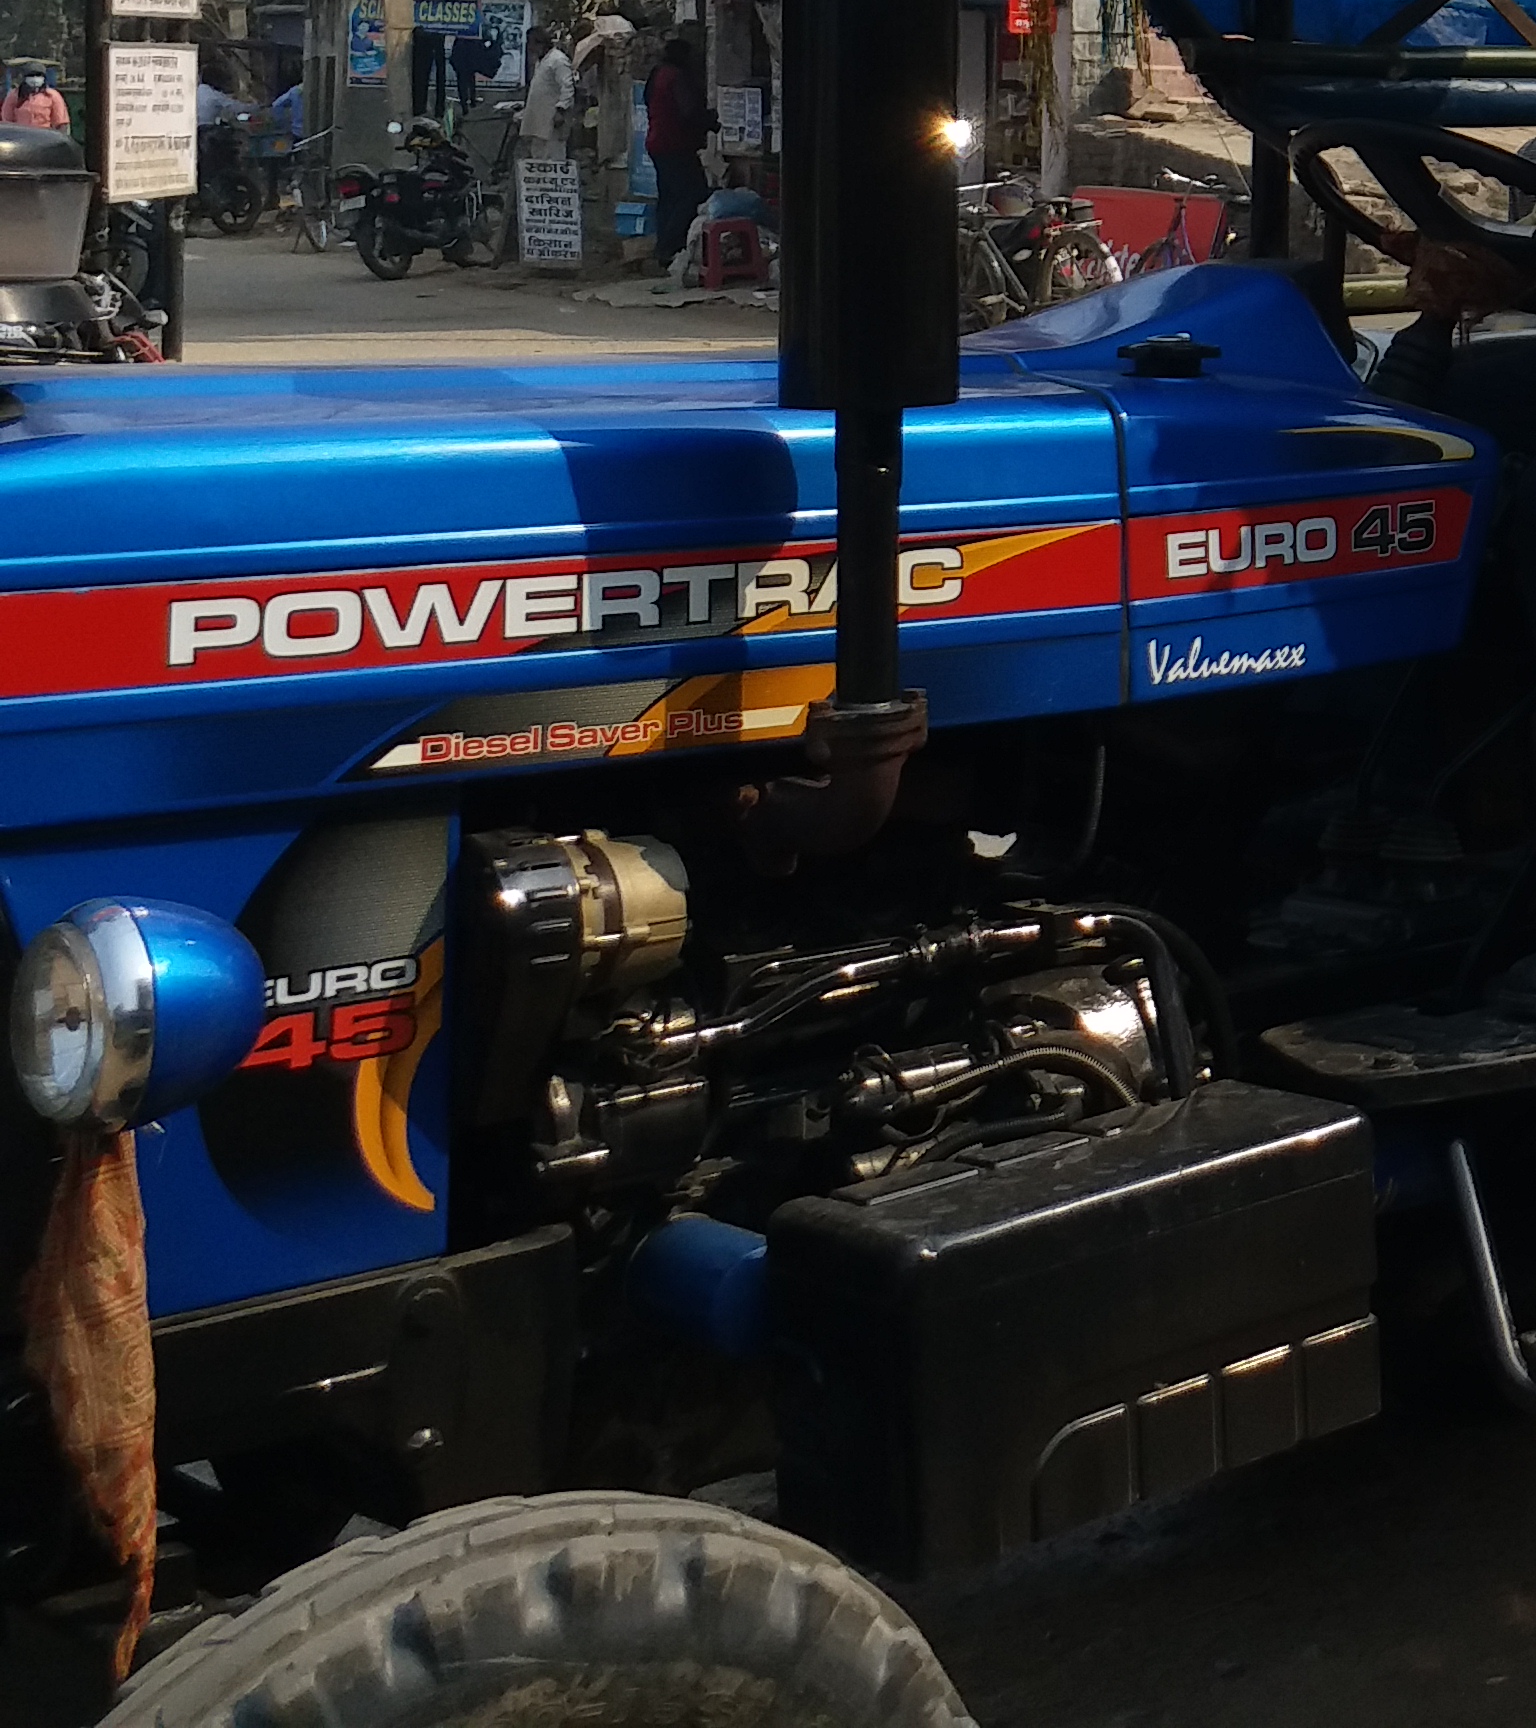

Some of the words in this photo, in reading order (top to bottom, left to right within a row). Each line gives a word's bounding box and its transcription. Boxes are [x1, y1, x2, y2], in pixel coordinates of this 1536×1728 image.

[419, 0, 476, 23] CLASSES
[528, 206, 574, 219] खारिज
[528, 235, 573, 249] किसान
[1166, 516, 1338, 580] EURO
[1351, 499, 1437, 556] 45
[1148, 636, 1307, 686] Valuemaxx
[419, 723, 544, 764] Diesel
[547, 718, 661, 755] Saver
[666, 708, 745, 742] Plus
[236, 998, 417, 1070] 45
